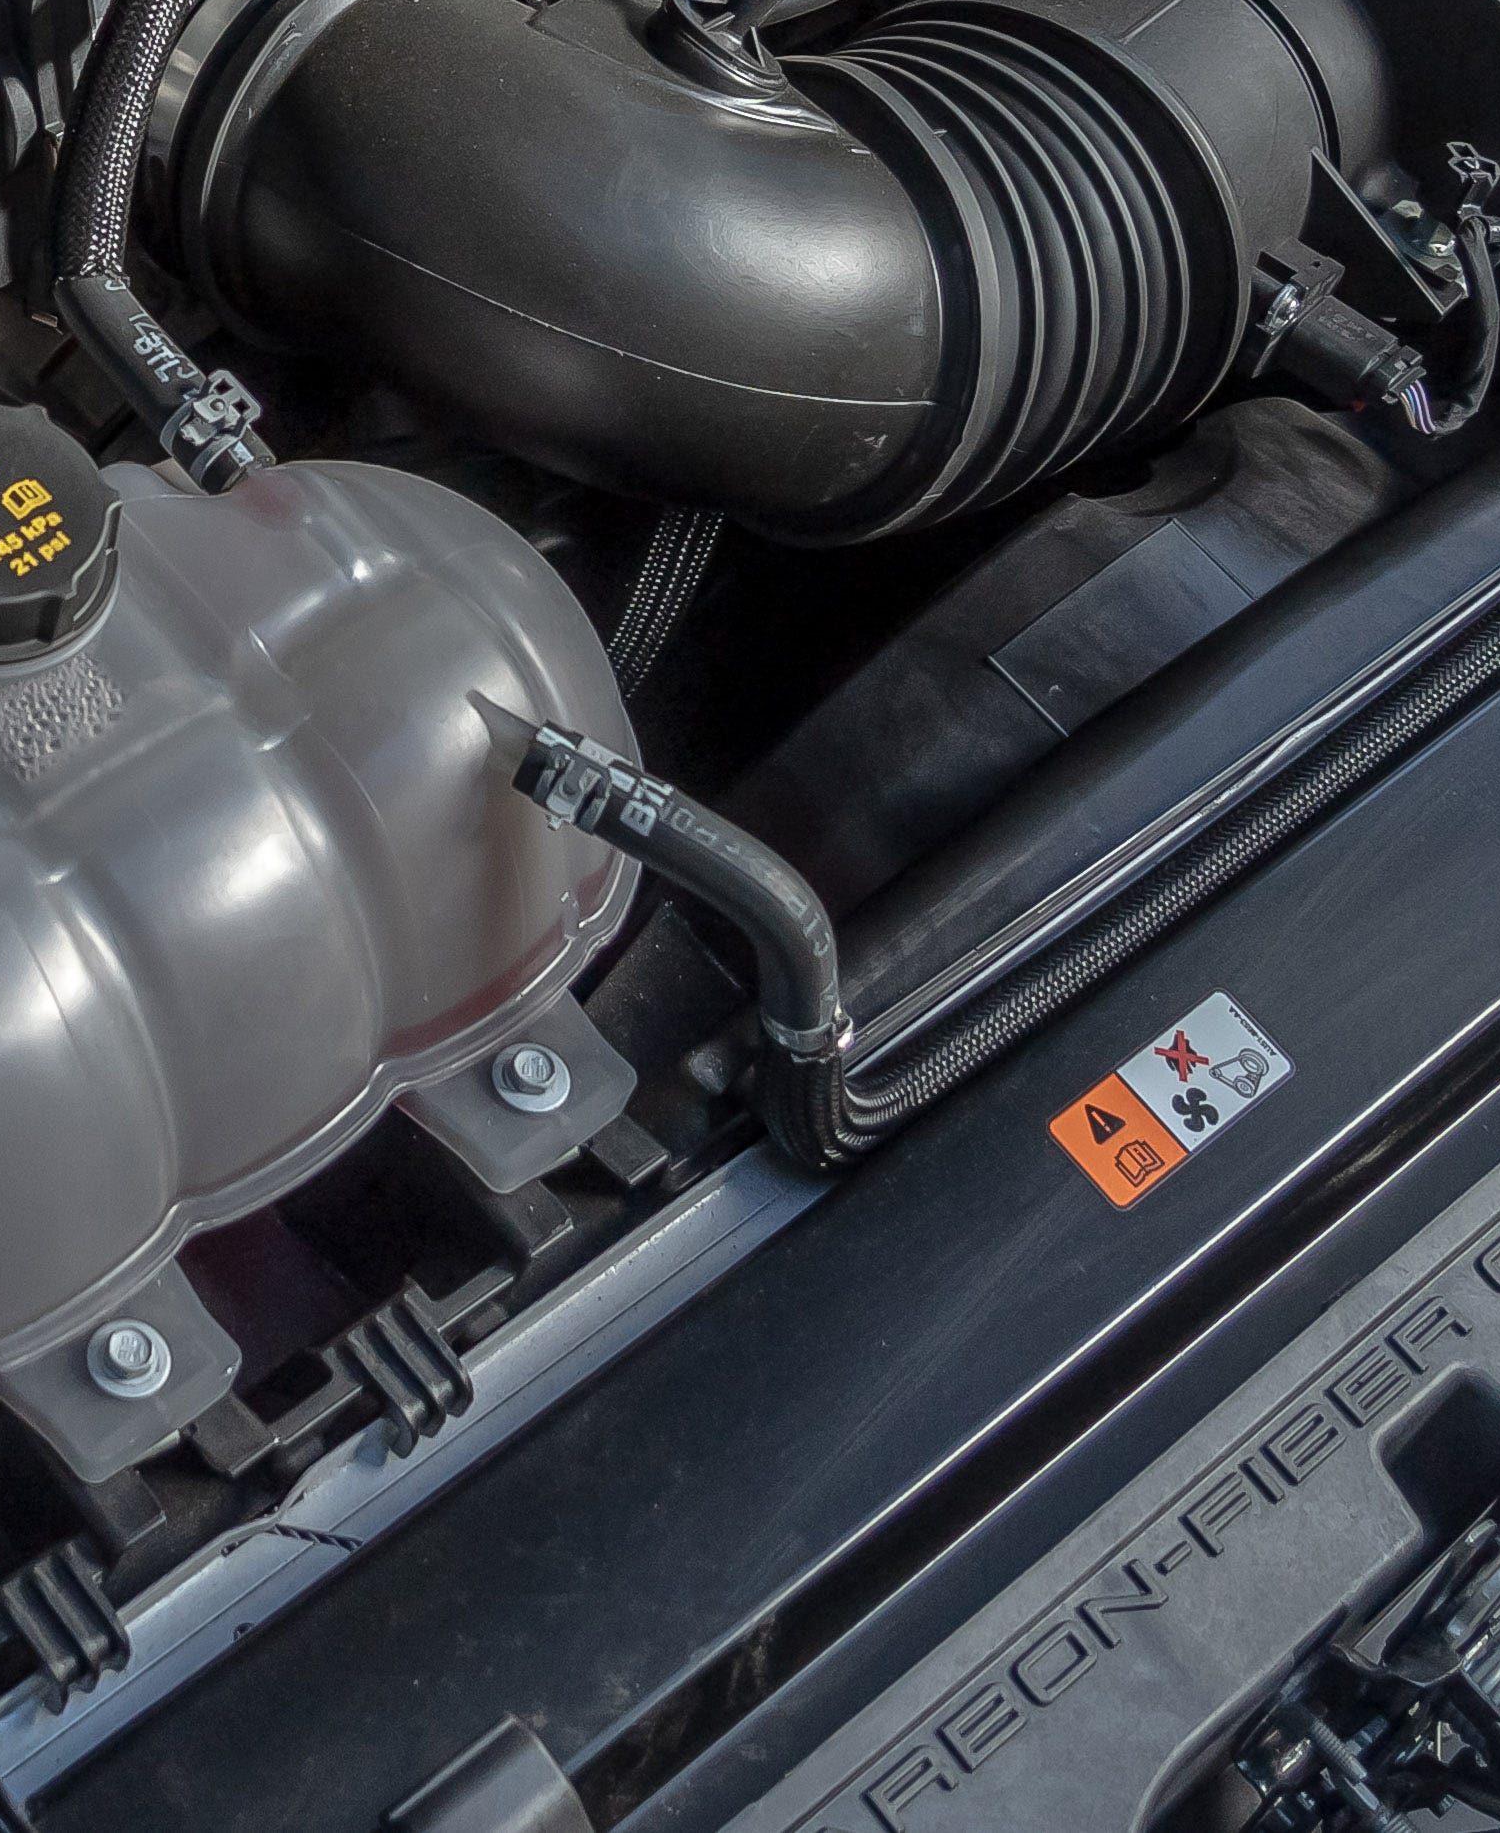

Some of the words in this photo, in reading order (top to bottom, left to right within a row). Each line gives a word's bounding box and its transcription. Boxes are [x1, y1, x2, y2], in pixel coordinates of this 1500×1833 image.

[20, 509, 63, 542] kPa
[10, 554, 39, 576] 21
[33, 531, 71, 562] psi
[815, 1295, 1474, 1833] RBON-FIBER
